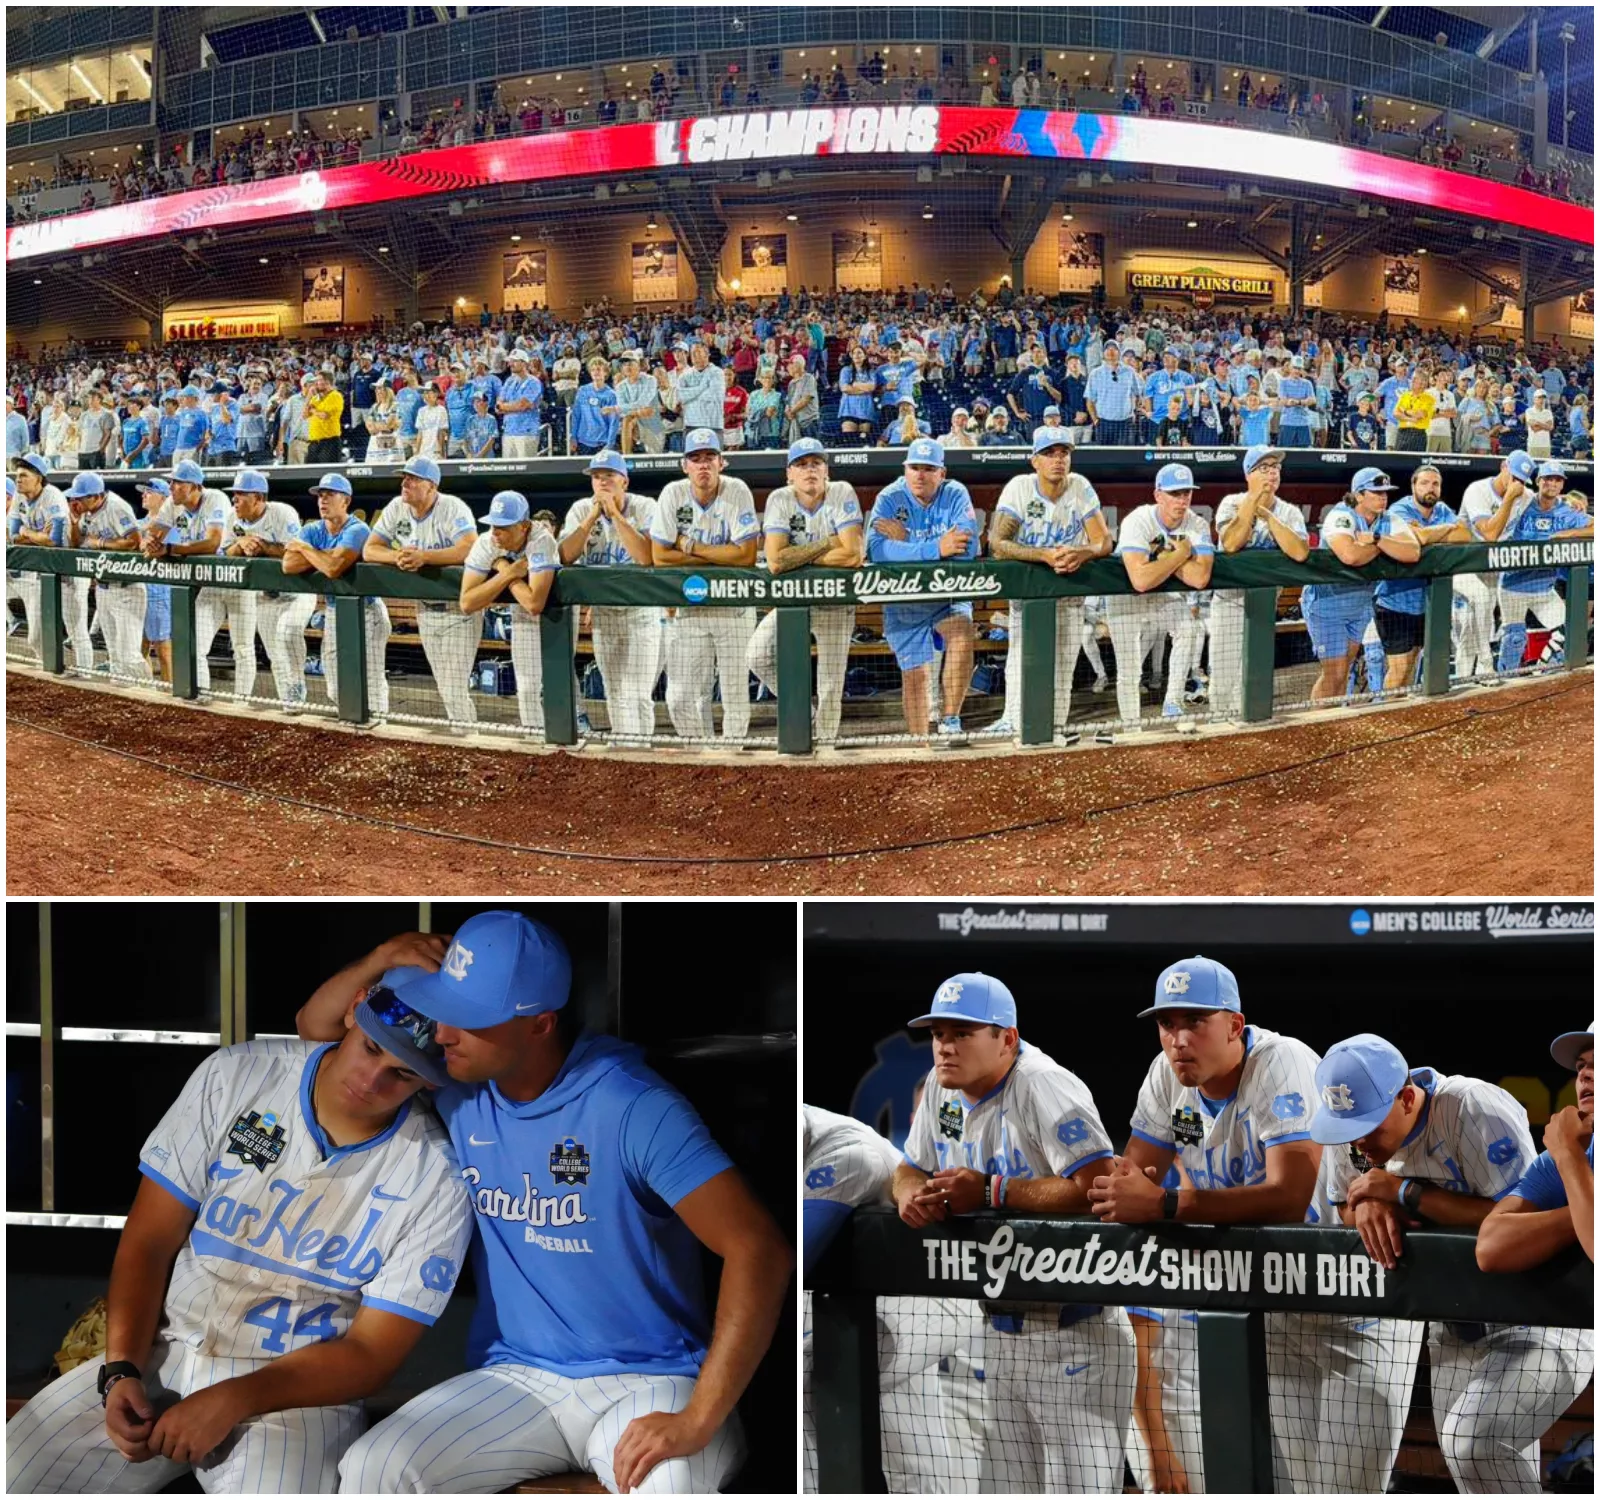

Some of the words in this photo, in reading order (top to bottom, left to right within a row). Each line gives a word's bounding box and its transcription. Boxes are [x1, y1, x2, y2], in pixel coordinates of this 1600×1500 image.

[567, 111, 580, 122] 16
[1188, 103, 1206, 115] 218
[687, 105, 940, 165] CHAMPIONS
[1132, 274, 1179, 289] GREAT
[1181, 276, 1230, 291] PLAINS
[1232, 279, 1273, 294] GRILL
[169, 322, 216, 340] SLICE
[834, 453, 868, 464] #MCWS
[75, 556, 95, 573] THE
[94, 552, 158, 579] Greatest
[157, 562, 192, 581] SHOW
[195, 564, 212, 581] ON
[215, 565, 246, 583] DIRT
[1488, 544, 1540, 569] NORTH
[711, 579, 766, 598] MEN'S
[771, 578, 846, 598] COLLEGE
[852, 570, 922, 595] World
[929, 568, 1002, 593] Series
[938, 913, 961, 930] THE
[960, 907, 1025, 936] Greatest
[1025, 913, 1060, 931] SHOW
[1061, 913, 1079, 931] ON
[1080, 913, 1108, 931] DIRT
[1373, 912, 1418, 932] MEN'S
[1421, 911, 1481, 931] COLLEGE
[1485, 906, 1542, 929] World
[1547, 905, 1594, 928] Serie
[230, 1130, 255, 1148] WORLD
[252, 1143, 278, 1161] SERIES
[243, 1129, 272, 1149] COLLEGE
[559, 1158, 582, 1166] COLLEGE
[461, 1166, 588, 1227] Carolina
[923, 1238, 979, 1281] THE
[978, 1225, 1158, 1299] Greatest
[1160, 1248, 1253, 1292] SHOW
[1263, 1252, 1306, 1295] ON
[1316, 1254, 1387, 1298] DIRT
[244, 1295, 344, 1355] 44
